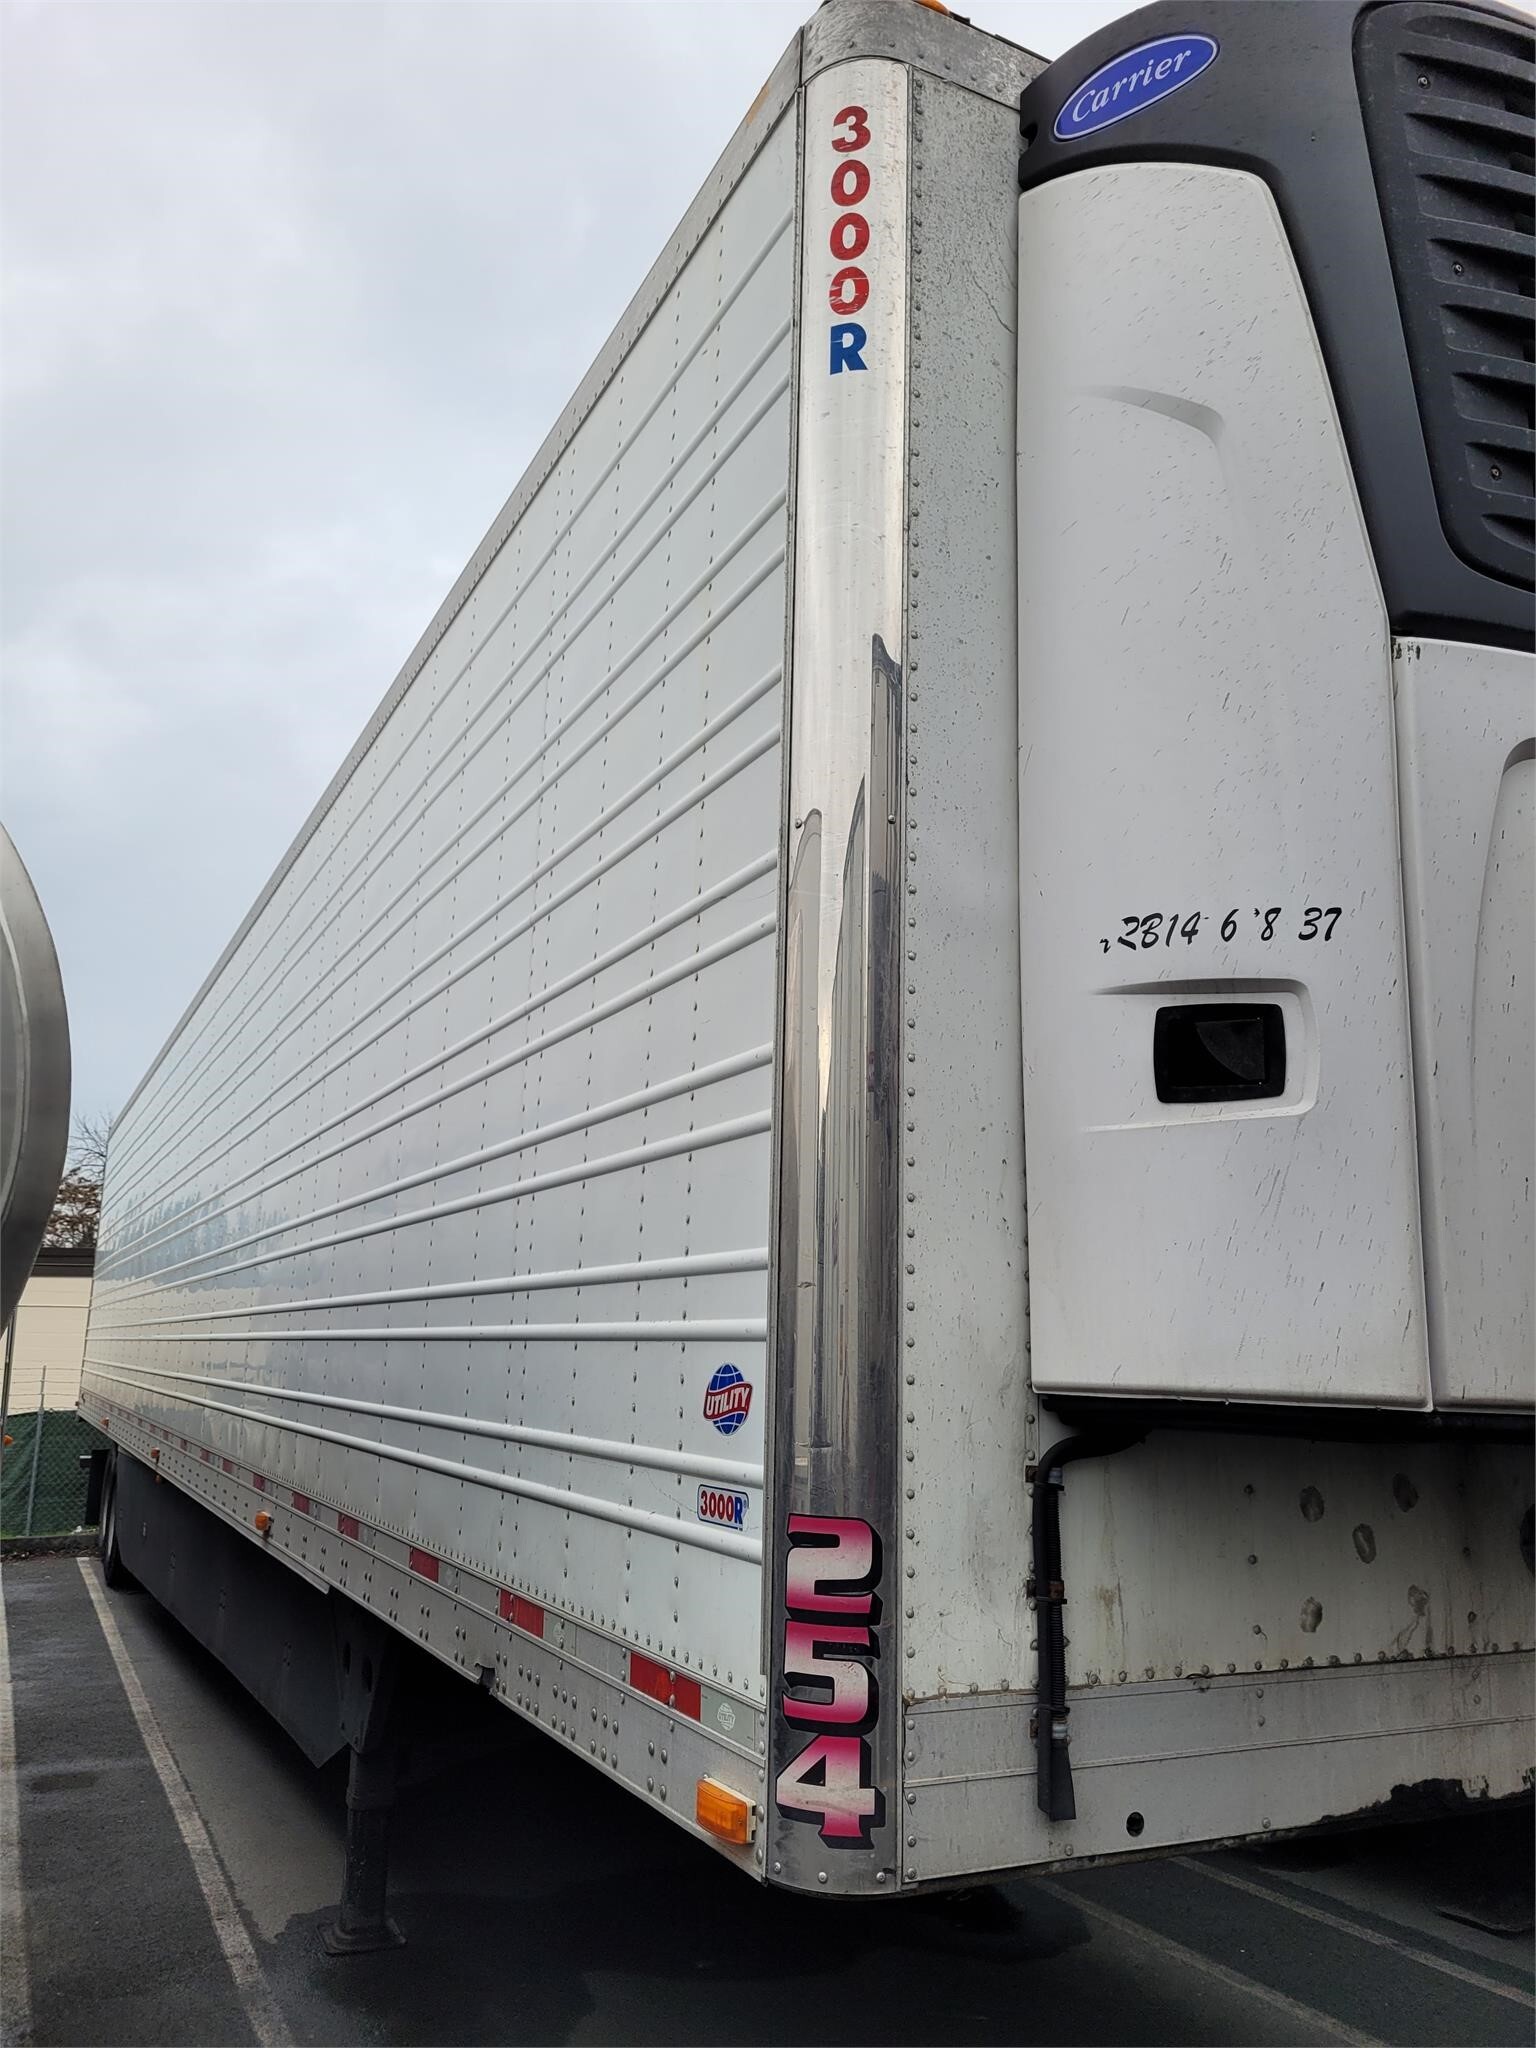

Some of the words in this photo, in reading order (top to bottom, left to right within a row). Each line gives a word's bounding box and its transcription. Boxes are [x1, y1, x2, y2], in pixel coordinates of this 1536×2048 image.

[1072, 50, 1192, 122] Carrier
[829, 105, 872, 376] 3000R
[705, 1387, 750, 1417] UTILITY
[700, 1490, 743, 1525] 3000R
[775, 1513, 886, 1850] 254
